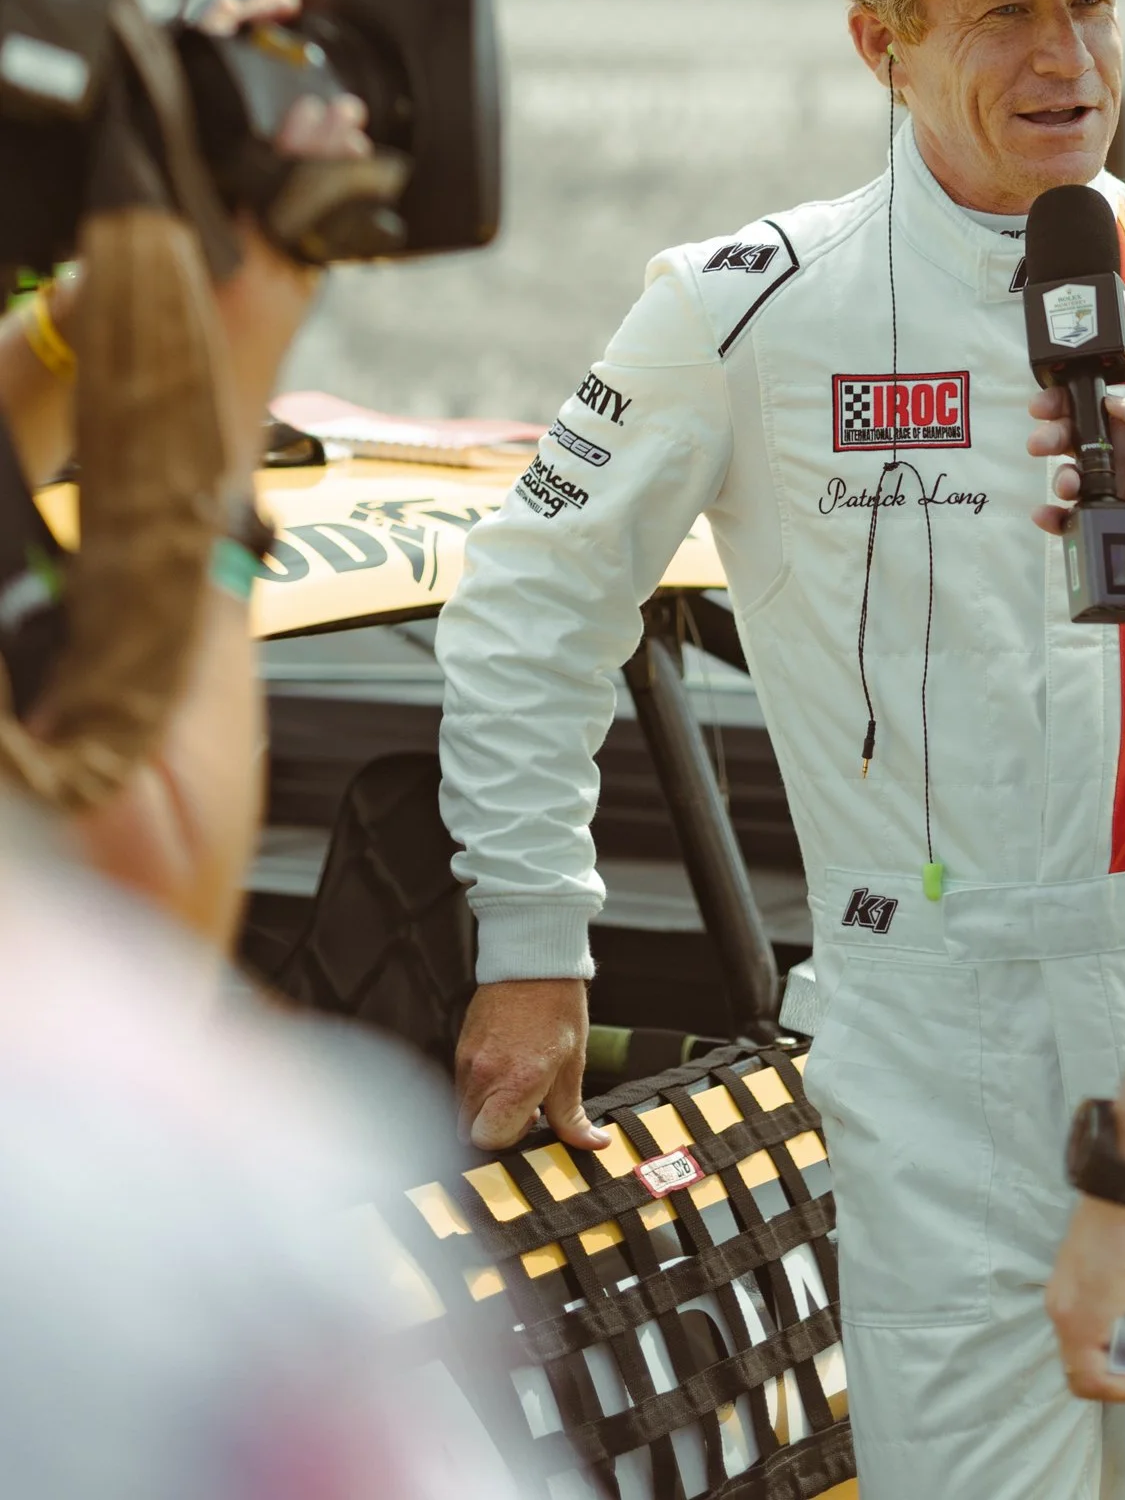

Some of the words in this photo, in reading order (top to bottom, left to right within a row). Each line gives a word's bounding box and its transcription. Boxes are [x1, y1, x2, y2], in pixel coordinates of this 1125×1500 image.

[702, 243, 779, 273] K1
[576, 371, 632, 426] ERTY
[873, 382, 958, 428] IROC
[549, 419, 611, 467] PEED
[844, 427, 893, 442] INTERNATIONAL
[894, 427, 911, 440] RACE
[913, 427, 921, 439] OF
[922, 426, 961, 439] CHAMPIONS
[521, 473, 565, 518] acing
[819, 473, 906, 514] Patrick
[917, 473, 990, 514] Long
[842, 888, 898, 934] K1
